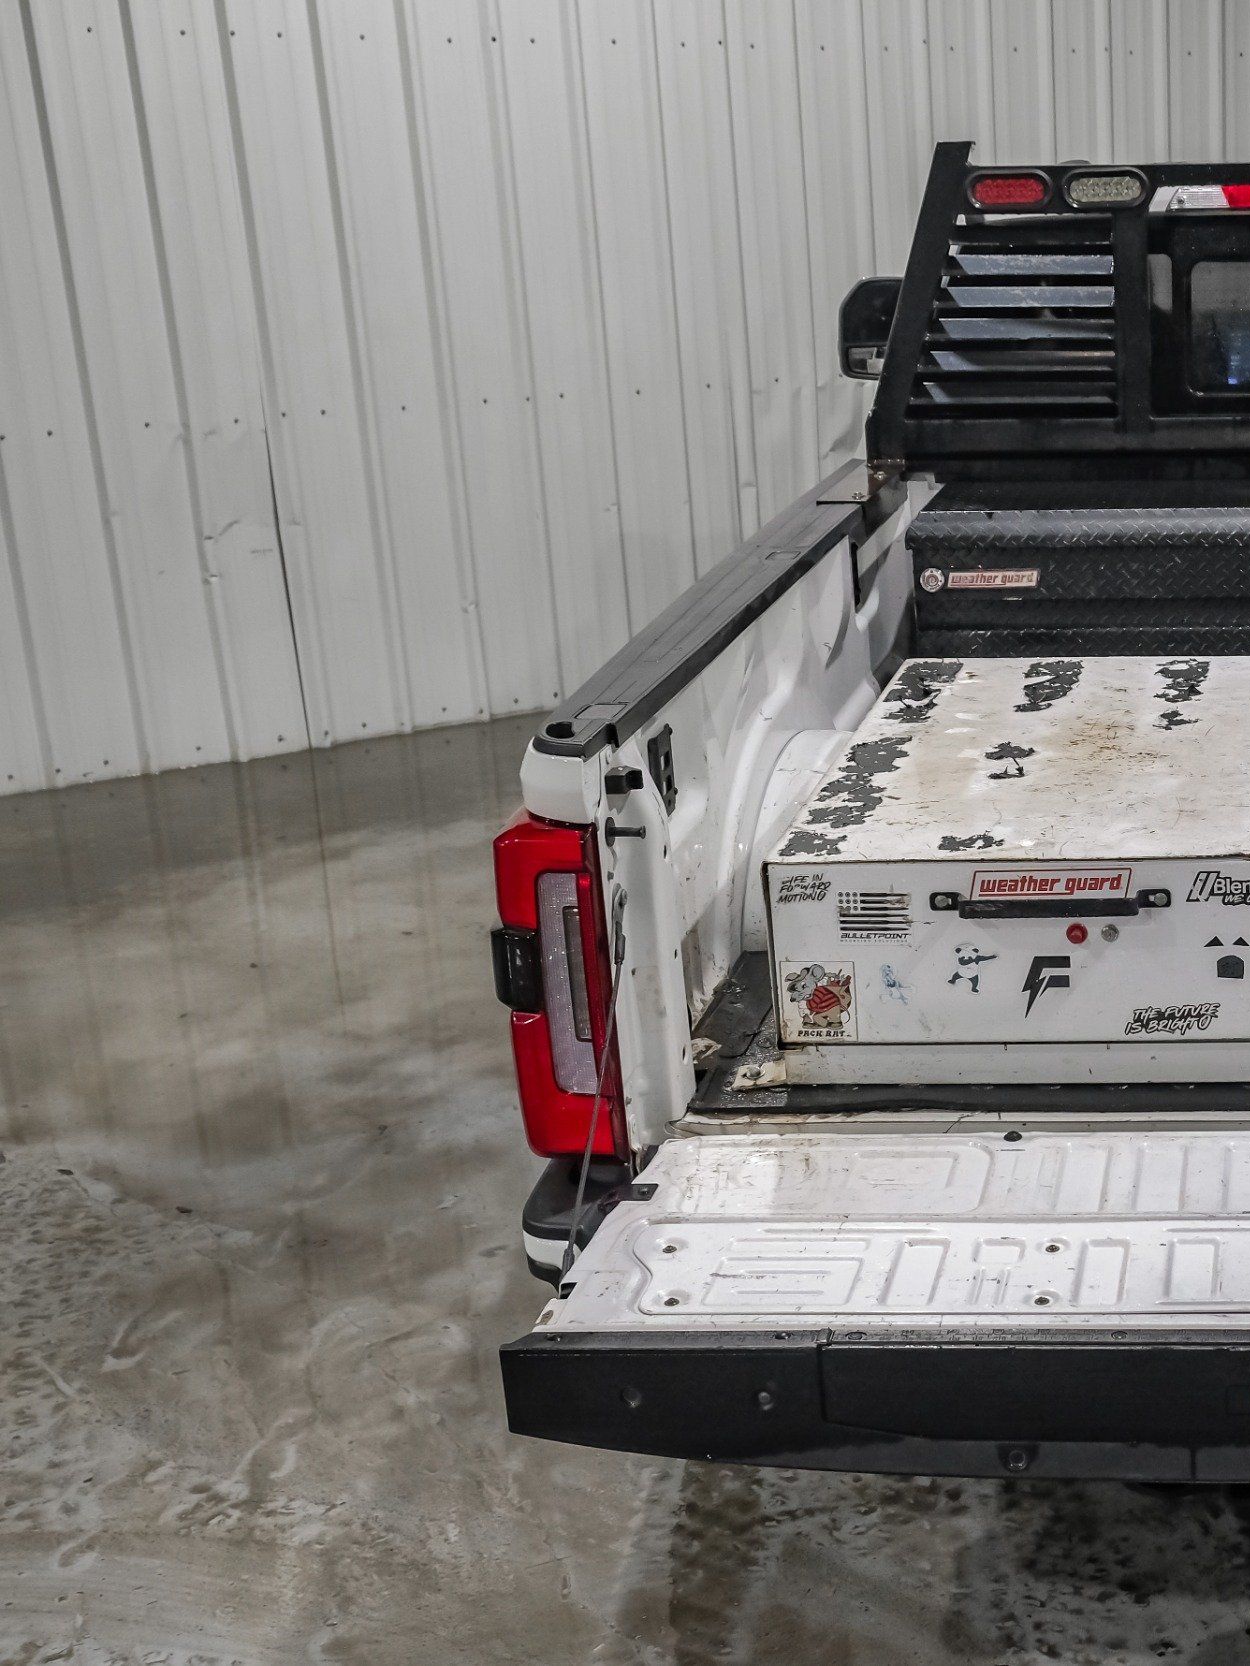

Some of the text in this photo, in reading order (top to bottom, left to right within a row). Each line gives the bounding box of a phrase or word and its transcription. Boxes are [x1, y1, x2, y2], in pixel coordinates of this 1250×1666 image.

[951, 573, 1034, 585] weather guard
[979, 873, 1123, 896] weather guard
[1223, 894, 1245, 903] WE
[1133, 1003, 1221, 1024] THE FUTURE
[797, 1029, 846, 1038] PACK RAT
[1124, 1015, 1200, 1036] IS BRIGHT
